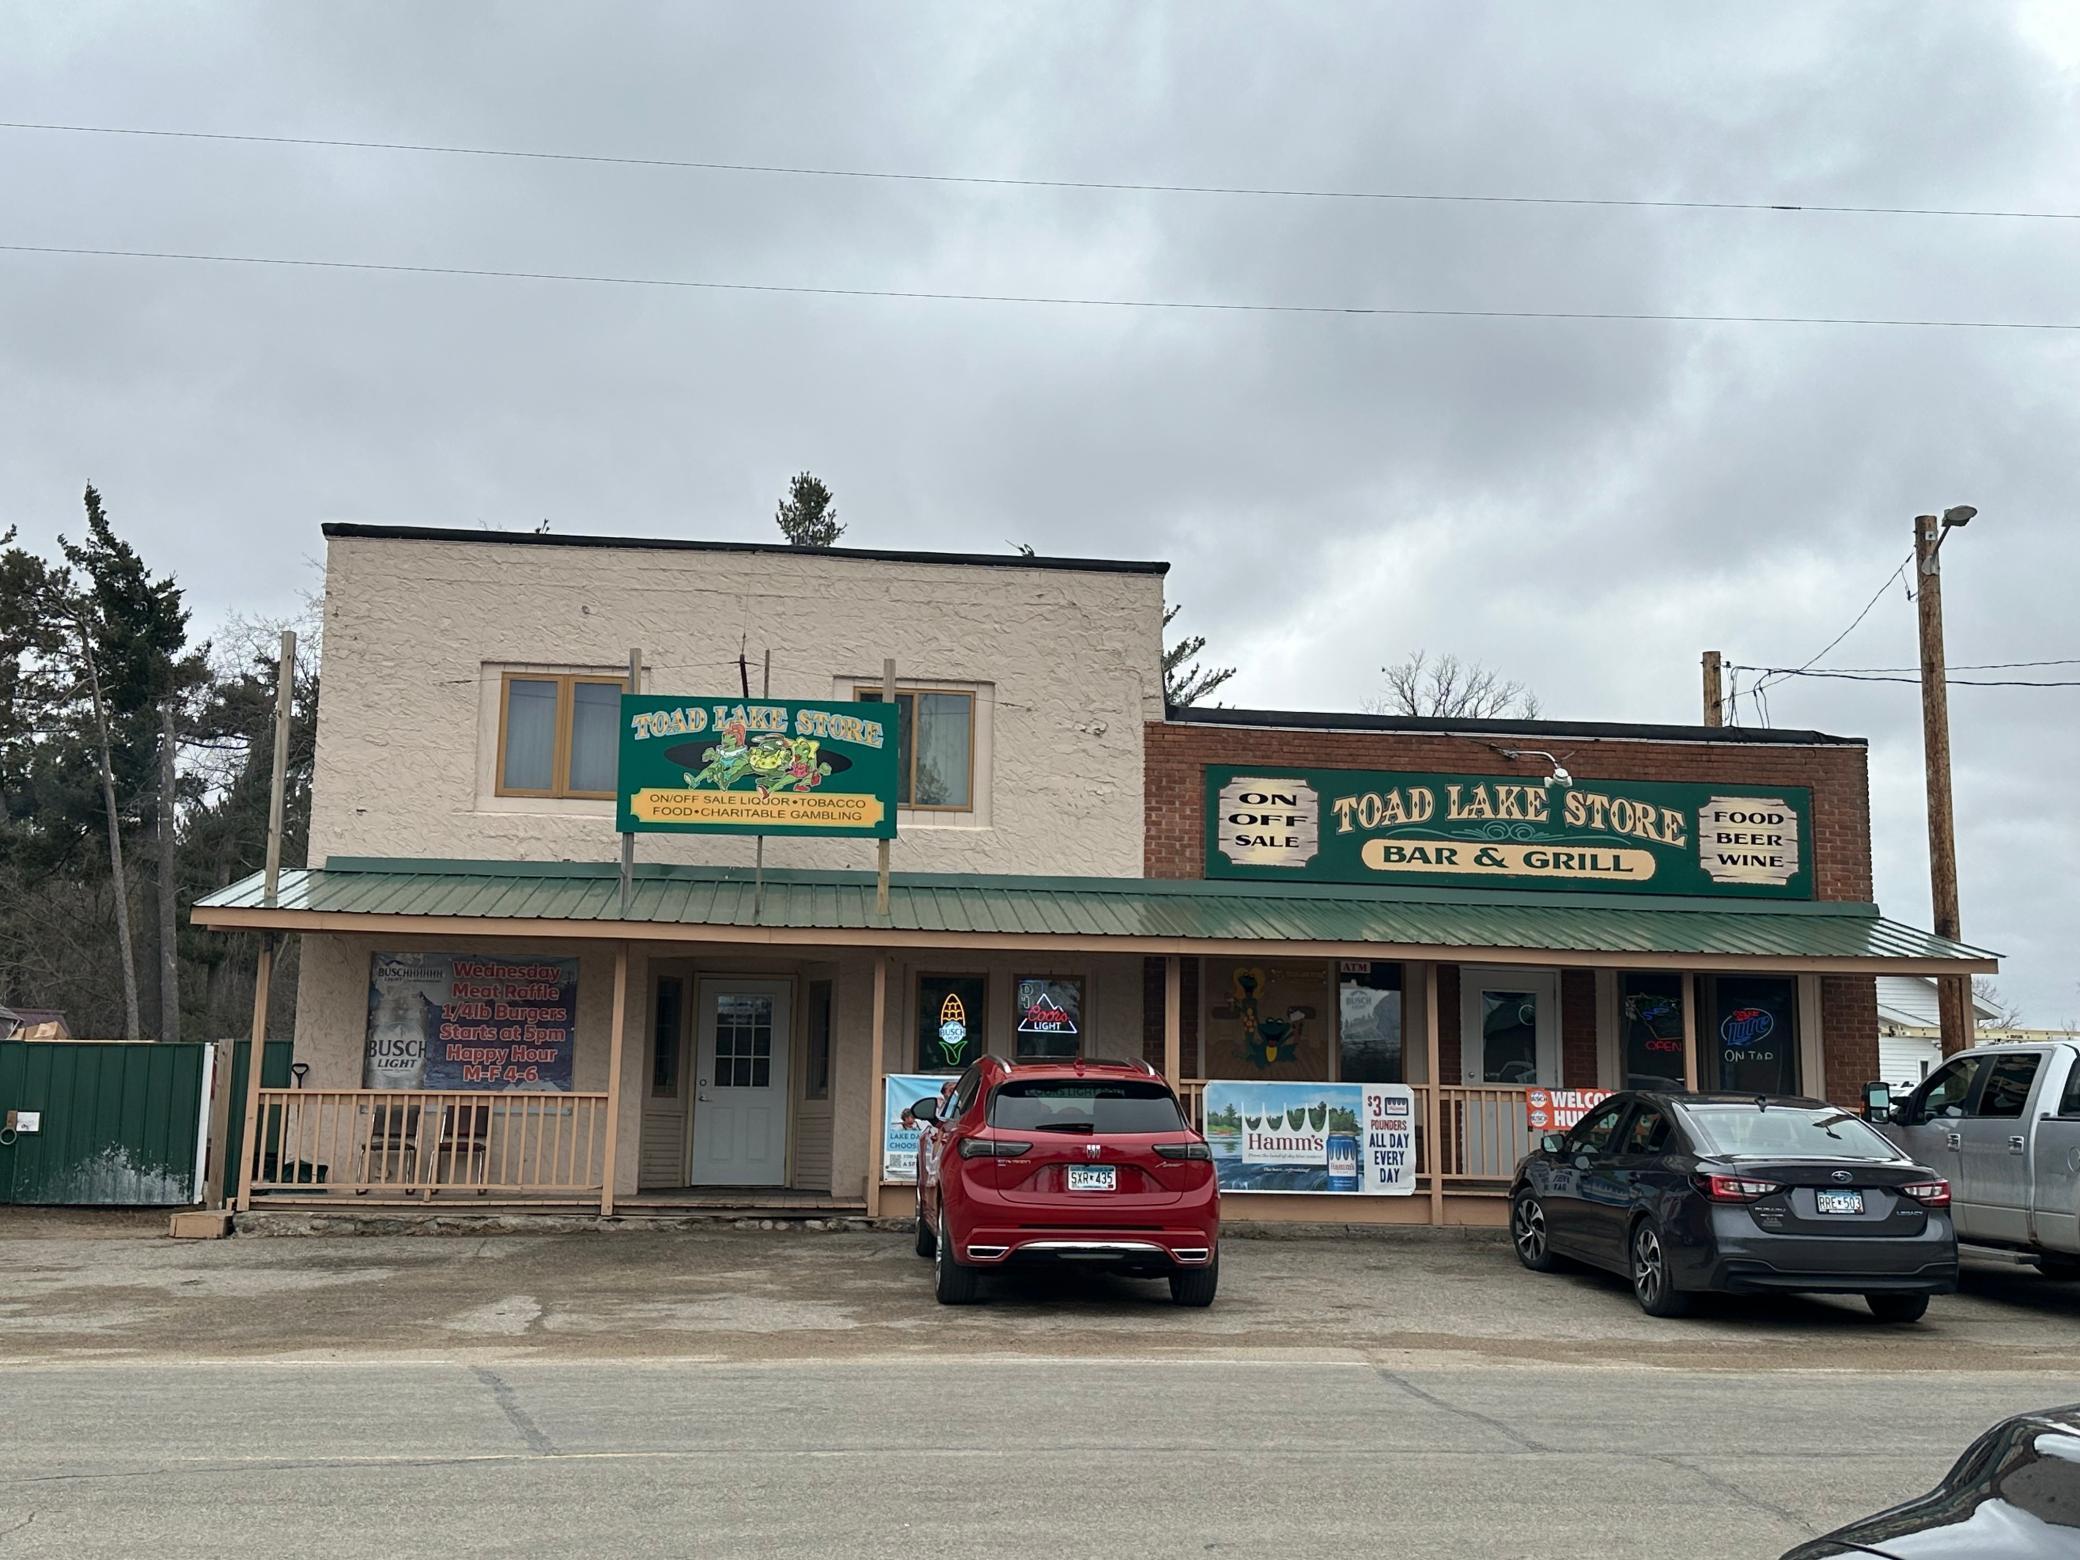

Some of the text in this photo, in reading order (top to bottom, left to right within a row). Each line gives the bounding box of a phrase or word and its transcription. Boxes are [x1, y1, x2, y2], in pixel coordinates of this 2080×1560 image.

[632, 704, 884, 748] TOAD LAKE STORE
[650, 794, 699, 804] ON/OFF
[704, 796, 735, 805] SALE
[1239, 793, 1297, 806] ON
[790, 810, 862, 821] GAMBLING
[1228, 813, 1308, 827] OFF
[1331, 782, 1686, 848] TOAD LAKE STORE
[1714, 811, 1784, 825] FOOD
[1235, 835, 1299, 848] SALE
[1716, 832, 1783, 846] BEER
[1383, 846, 1634, 872] BAR & GRILL
[1716, 853, 1784, 867] WINE
[452, 961, 561, 981] Wednesday
[1343, 963, 1367, 971] ATM
[452, 983, 560, 1000] Meat Raffle
[441, 1003, 567, 1024] 1/4lb Burgers
[1025, 1004, 1069, 1022] Coors
[1034, 1021, 1061, 1030] LIGHT
[439, 1024, 566, 1044] Starts at 5pm
[368, 1039, 427, 1058] BUSCH
[1645, 1040, 1682, 1052] OPEN
[446, 1044, 558, 1064] Happy Hour
[1725, 1049, 1745, 1062] ON
[378, 1058, 417, 1068] LIGHT
[463, 1066, 539, 1082] M-F 4-6
[1368, 1095, 1381, 1116] $3
[1551, 1091, 1616, 1109] WELCO
[1370, 1119, 1407, 1131] POUNDERS
[890, 1132, 908, 1140] LAKE
[1248, 1133, 1324, 1151] Hamm's
[1369, 1133, 1409, 1148] ALL DAY
[1374, 1151, 1404, 1166] EVERY
[1071, 1171, 1113, 1185] SXR 435
[1380, 1168, 1400, 1183] DAY
[1843, 1197, 1862, 1209] 503
